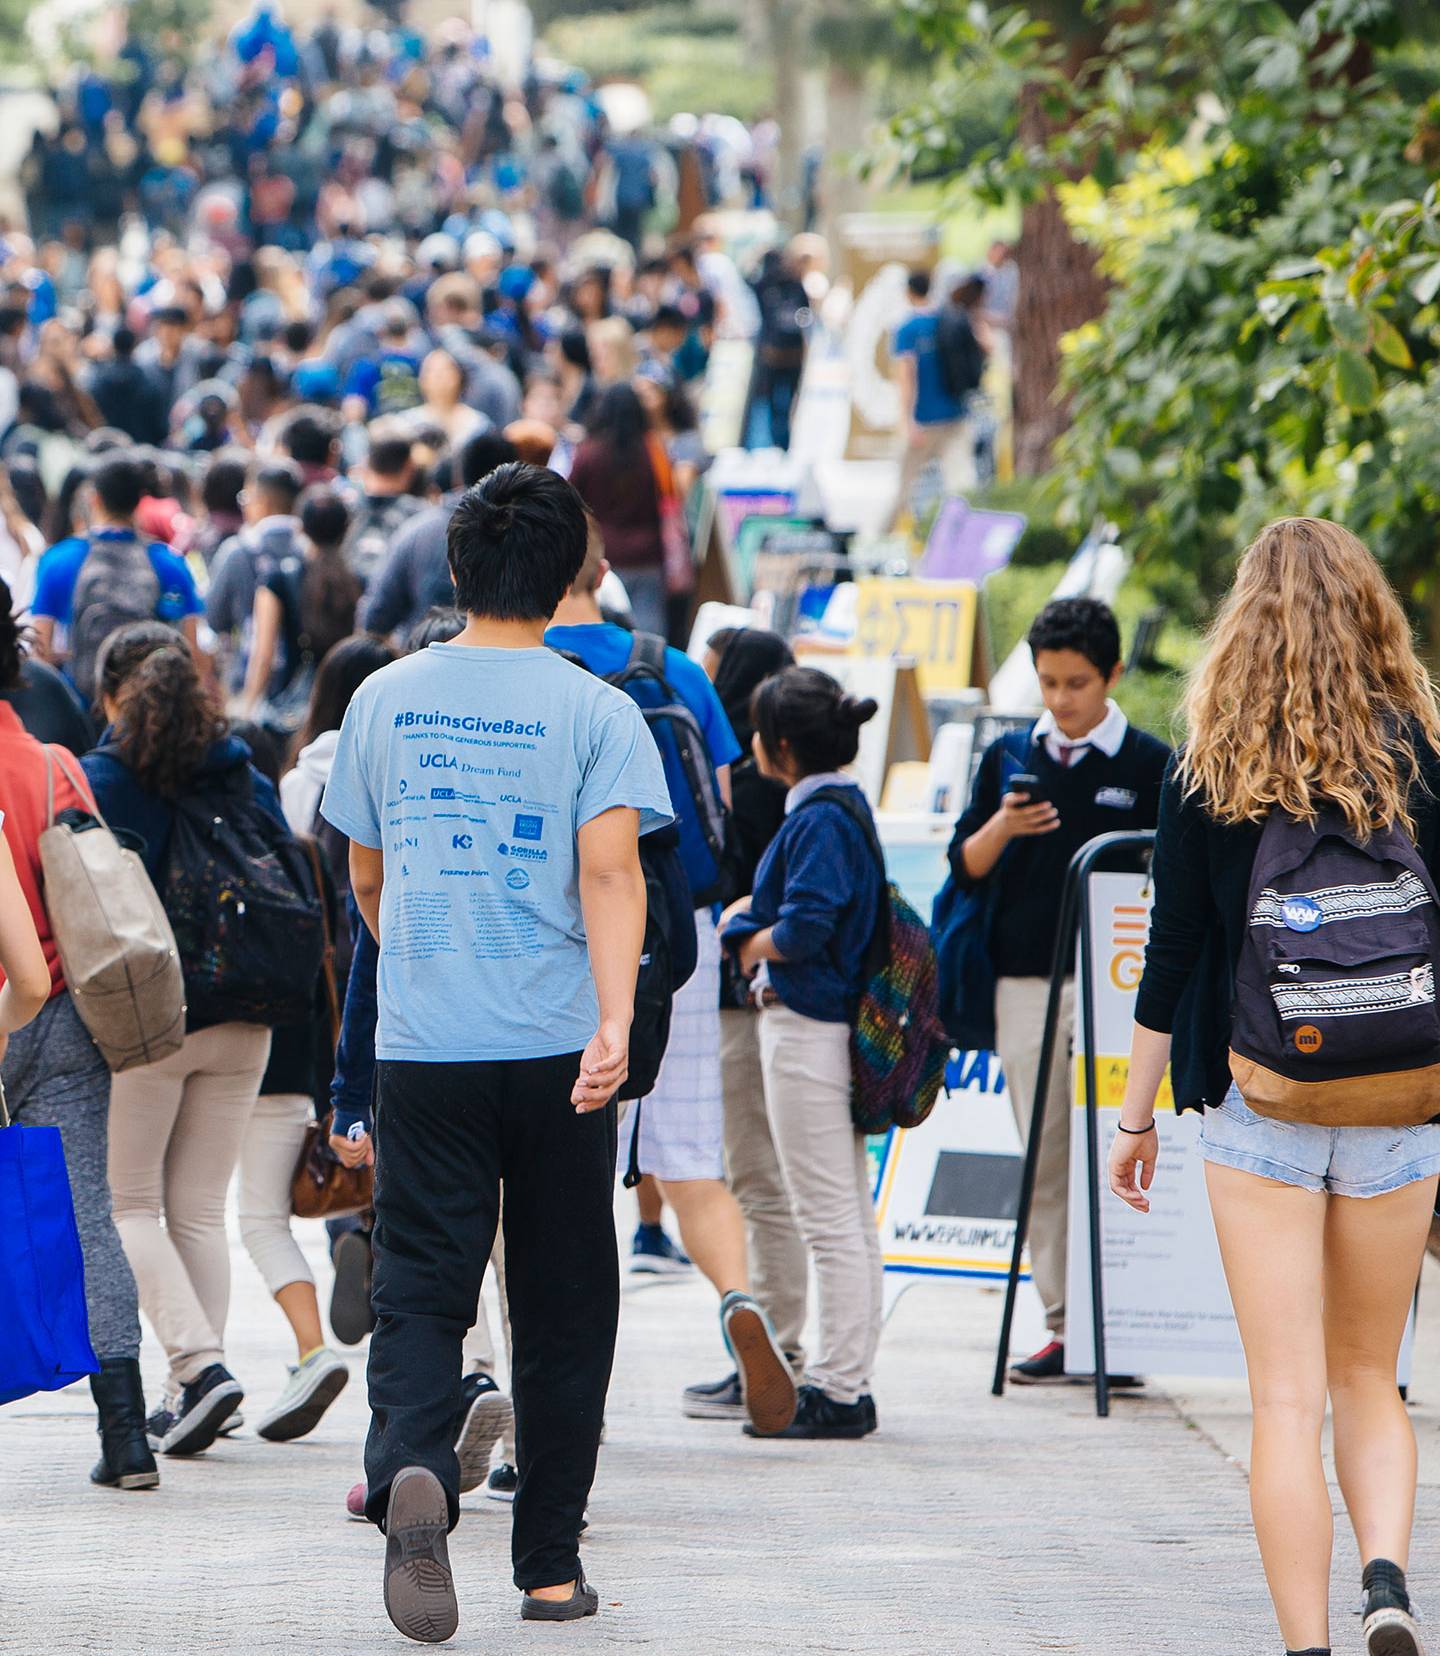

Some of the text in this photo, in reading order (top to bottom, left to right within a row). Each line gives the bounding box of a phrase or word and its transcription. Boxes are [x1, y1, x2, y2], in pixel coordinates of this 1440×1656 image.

[394, 711, 547, 737] #BruinsGiveBack
[403, 732, 429, 741] THANKS
[430, 732, 439, 740] TO
[455, 736, 492, 747] GENEROUS
[419, 753, 522, 778] UCLA Dream Fund
[433, 790, 456, 798] UCLA
[500, 795, 522, 804] UCLA
